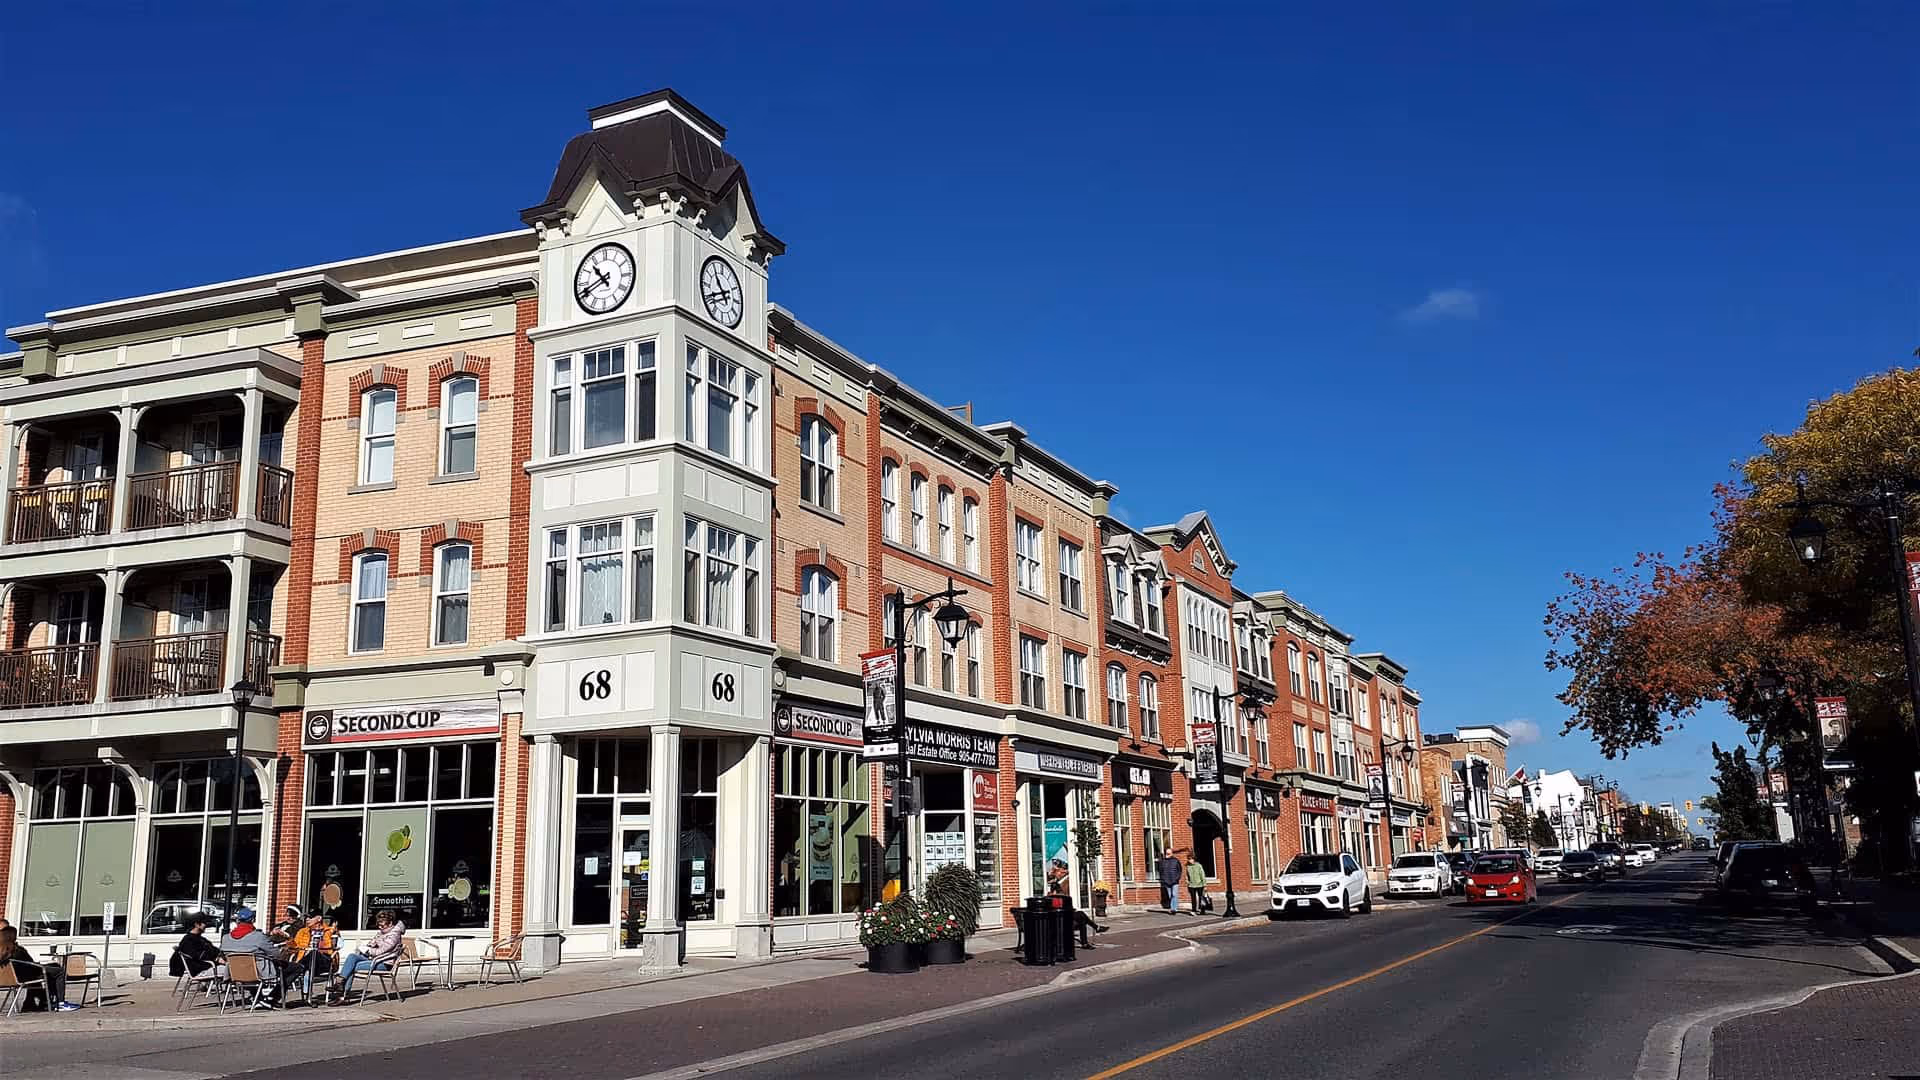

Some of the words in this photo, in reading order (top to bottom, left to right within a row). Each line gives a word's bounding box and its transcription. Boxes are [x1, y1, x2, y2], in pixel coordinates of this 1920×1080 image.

[579, 669, 612, 701] 68
[711, 672, 735, 702] 68
[338, 713, 404, 733] SECOND
[406, 711, 441, 729] CUP
[796, 713, 833, 733] SECOND
[834, 720, 853, 736] CUP
[917, 743, 938, 758] Estate
[938, 747, 958, 760] Office
[936, 731, 971, 750] MORRIS
[973, 737, 996, 754] TEAM
[374, 896, 414, 905] Smoothies
